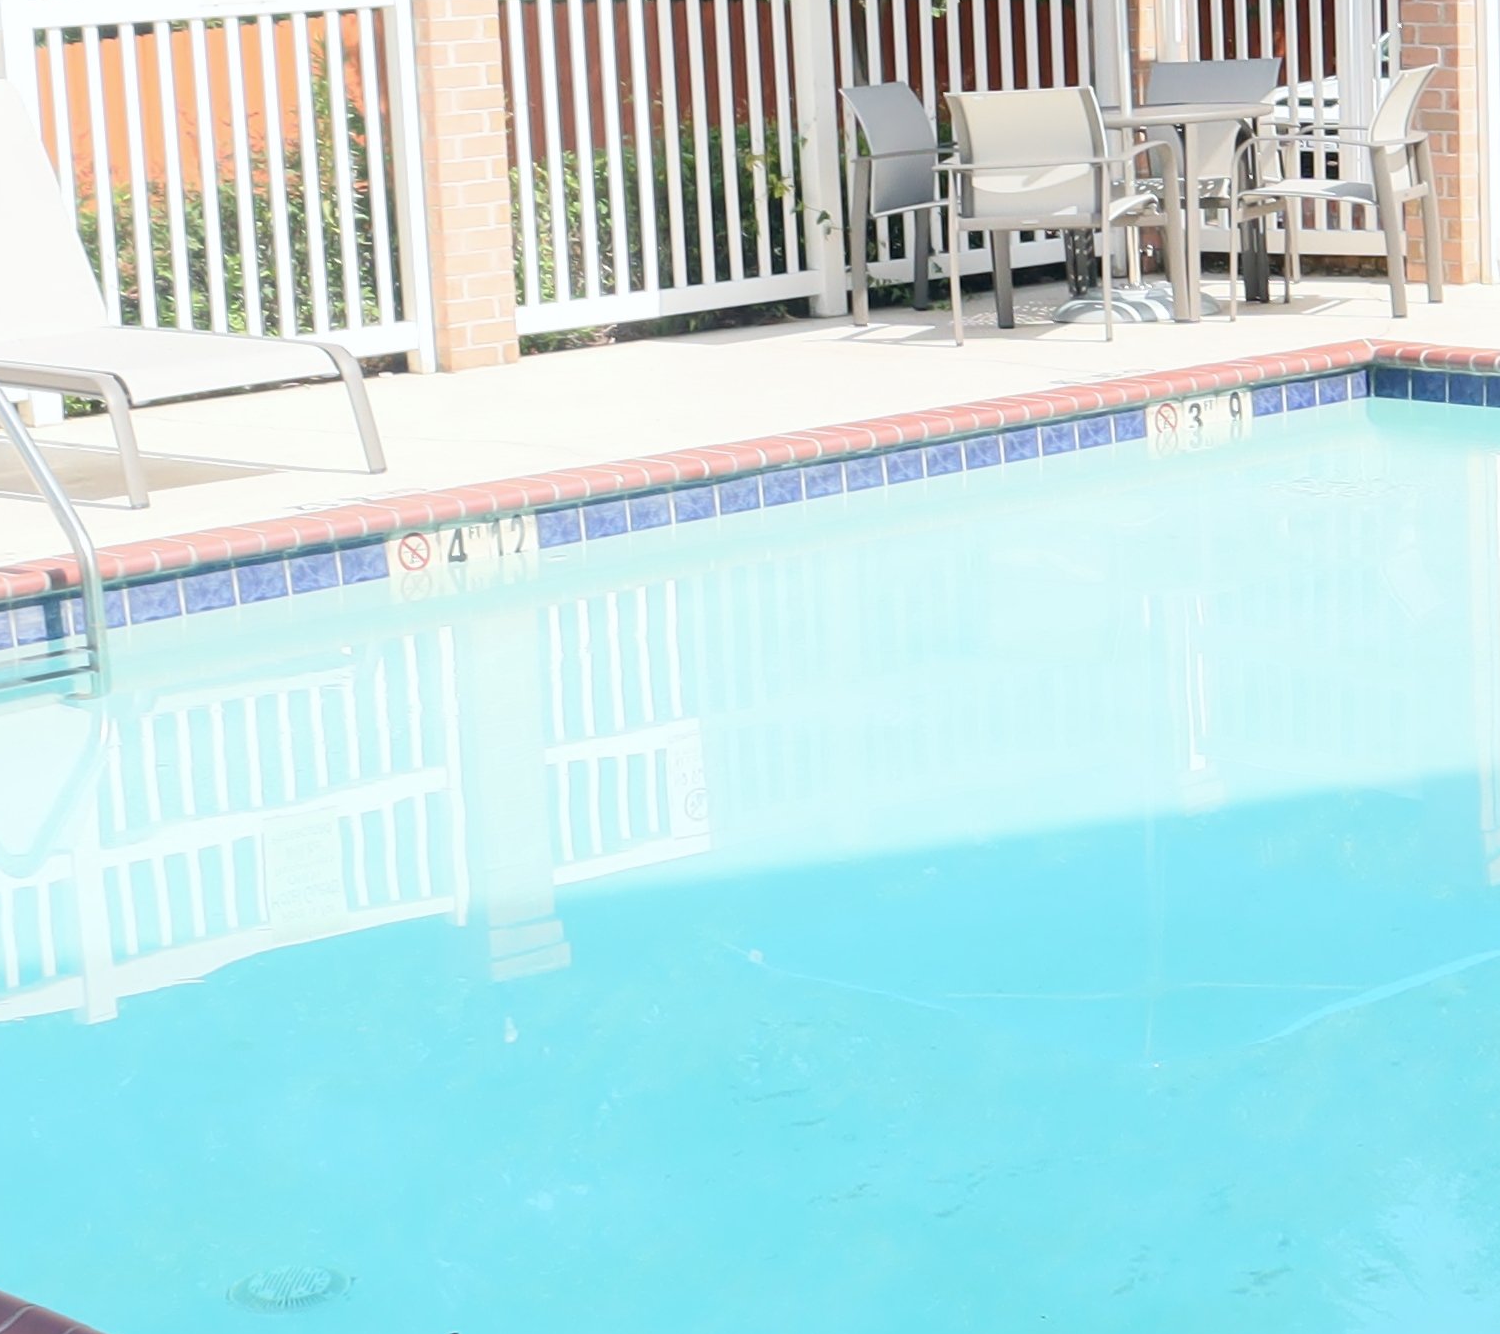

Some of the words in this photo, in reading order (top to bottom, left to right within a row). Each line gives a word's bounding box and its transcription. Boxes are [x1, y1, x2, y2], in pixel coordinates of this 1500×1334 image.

[1187, 402, 1204, 429] 3
[447, 528, 468, 563] 4
[468, 526, 481, 539] FT
